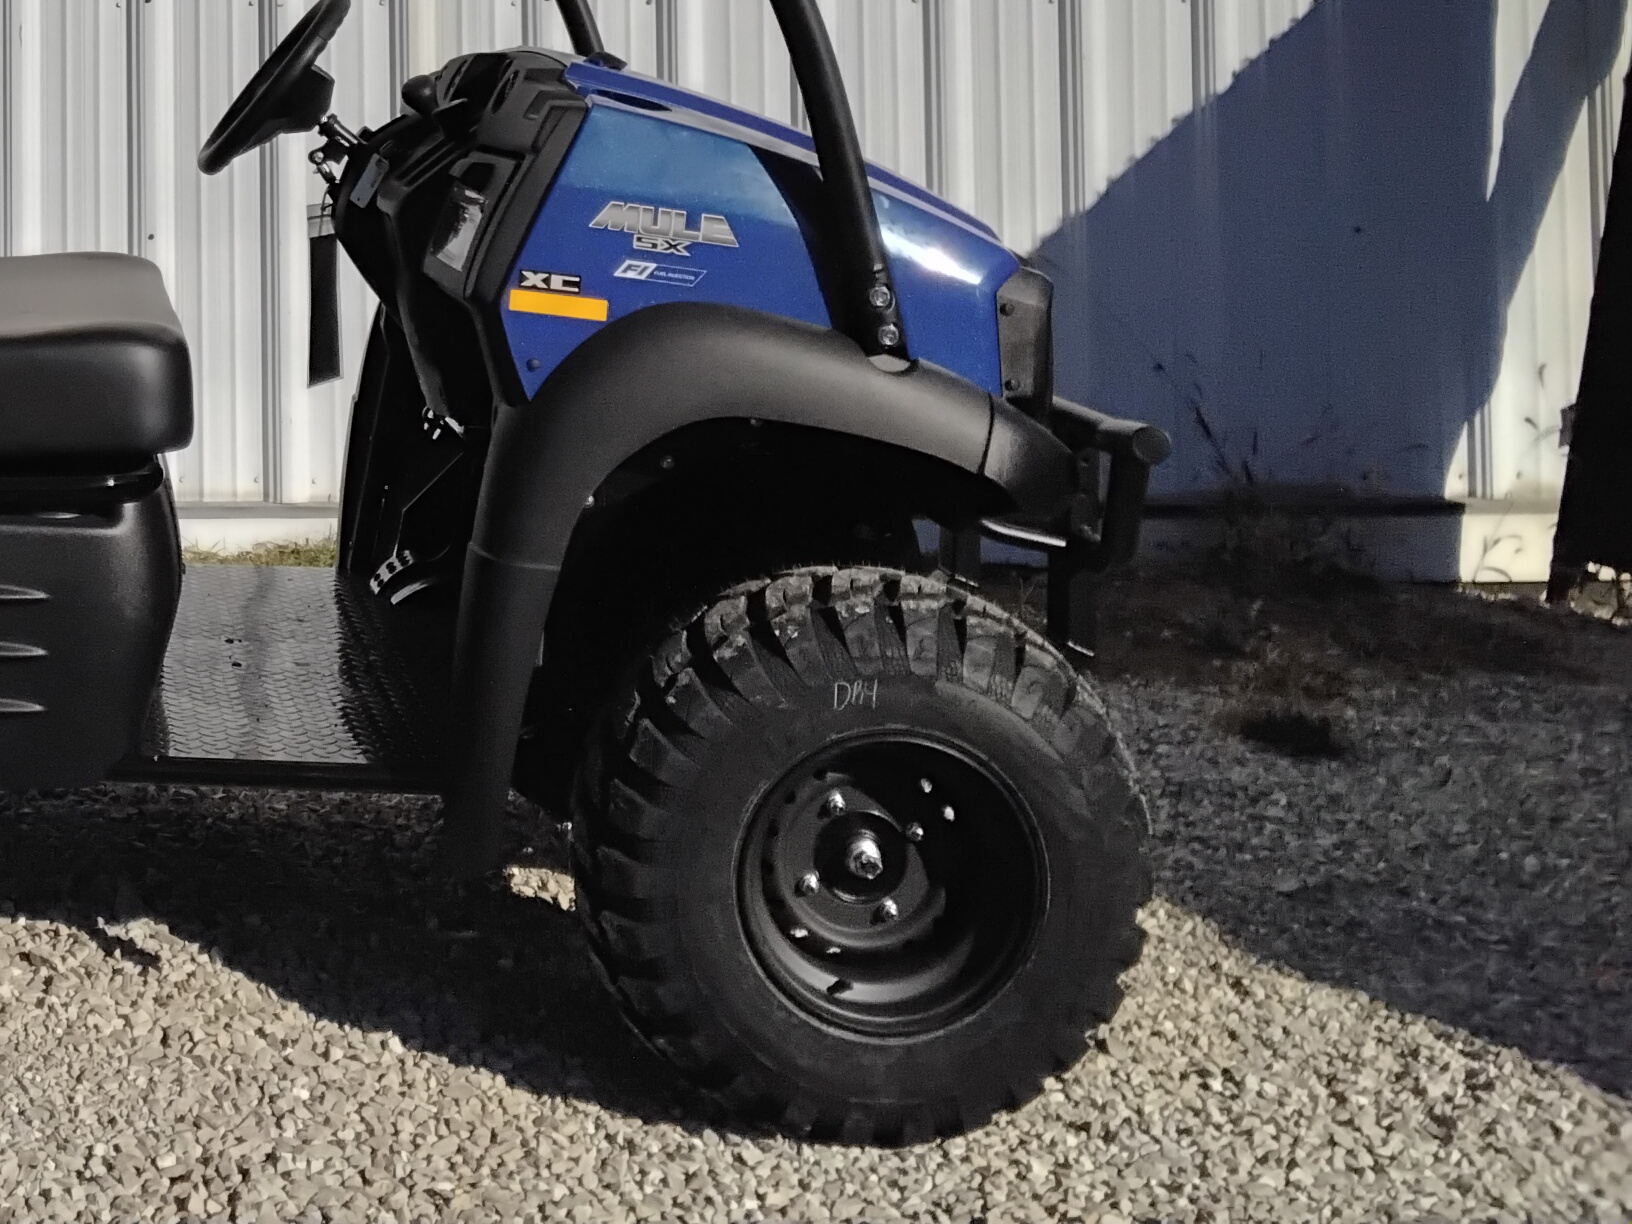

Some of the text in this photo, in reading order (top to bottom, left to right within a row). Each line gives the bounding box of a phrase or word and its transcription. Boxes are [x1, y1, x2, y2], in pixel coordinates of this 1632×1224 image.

[589, 201, 739, 247] MULE
[620, 263, 650, 276] FI
[520, 270, 580, 292] XC
